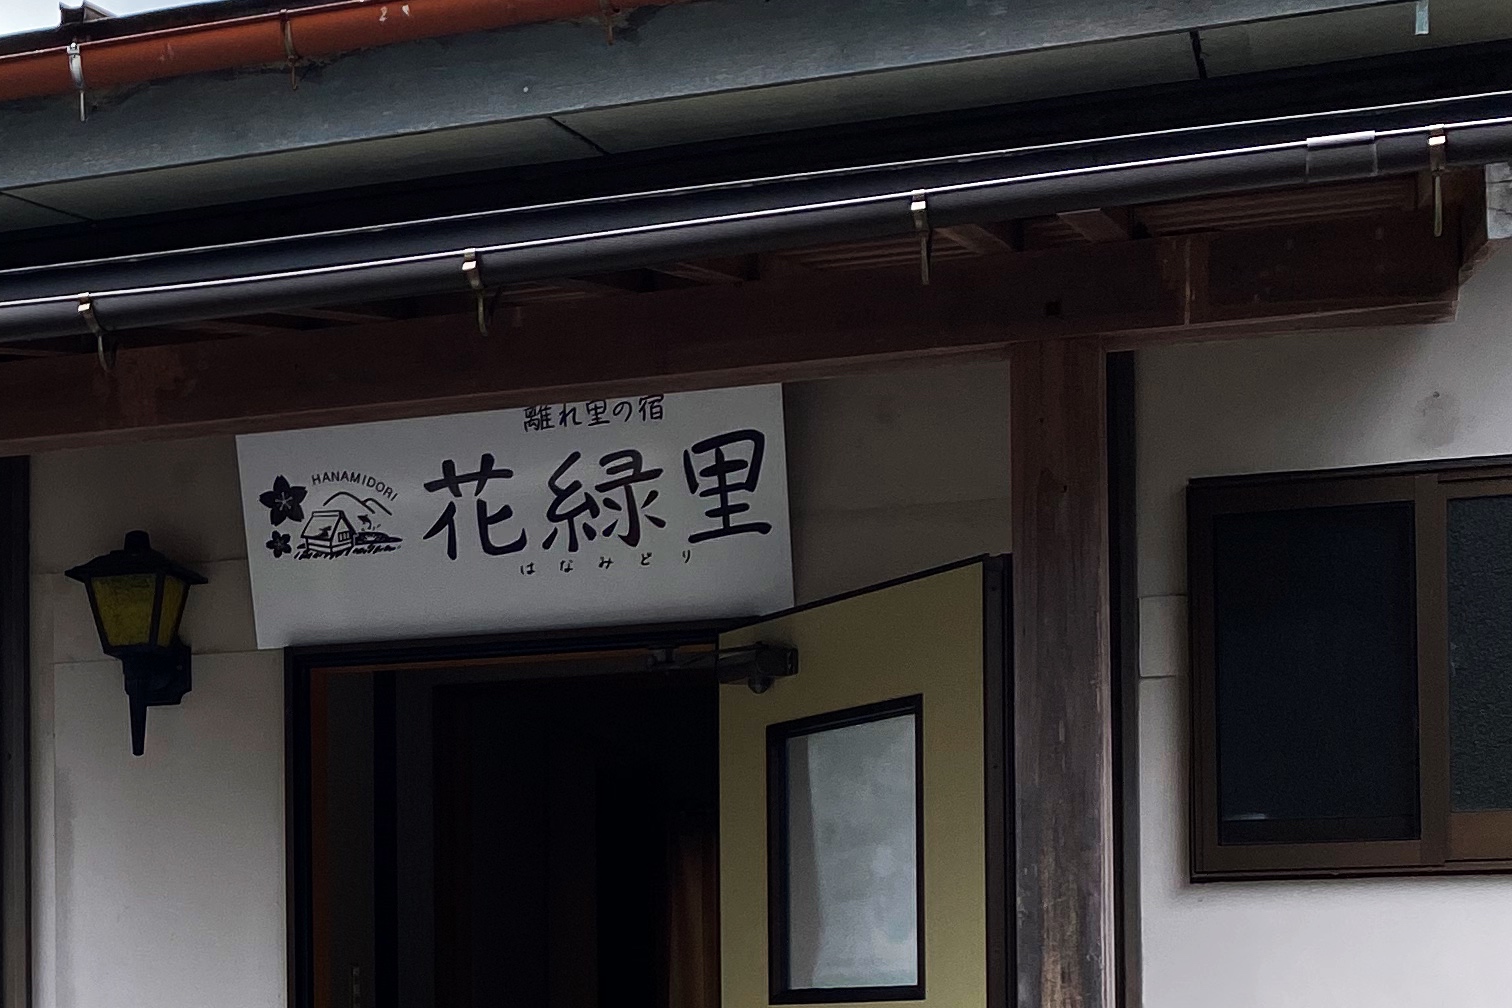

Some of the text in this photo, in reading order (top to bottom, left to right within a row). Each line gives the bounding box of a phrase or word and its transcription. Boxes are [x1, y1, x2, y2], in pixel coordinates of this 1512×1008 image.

[523, 393, 664, 432] 離れ里の宿
[312, 470, 398, 502] HANAMIDORI
[423, 429, 772, 560] 花緑里
[520, 549, 692, 575] はなみどり
